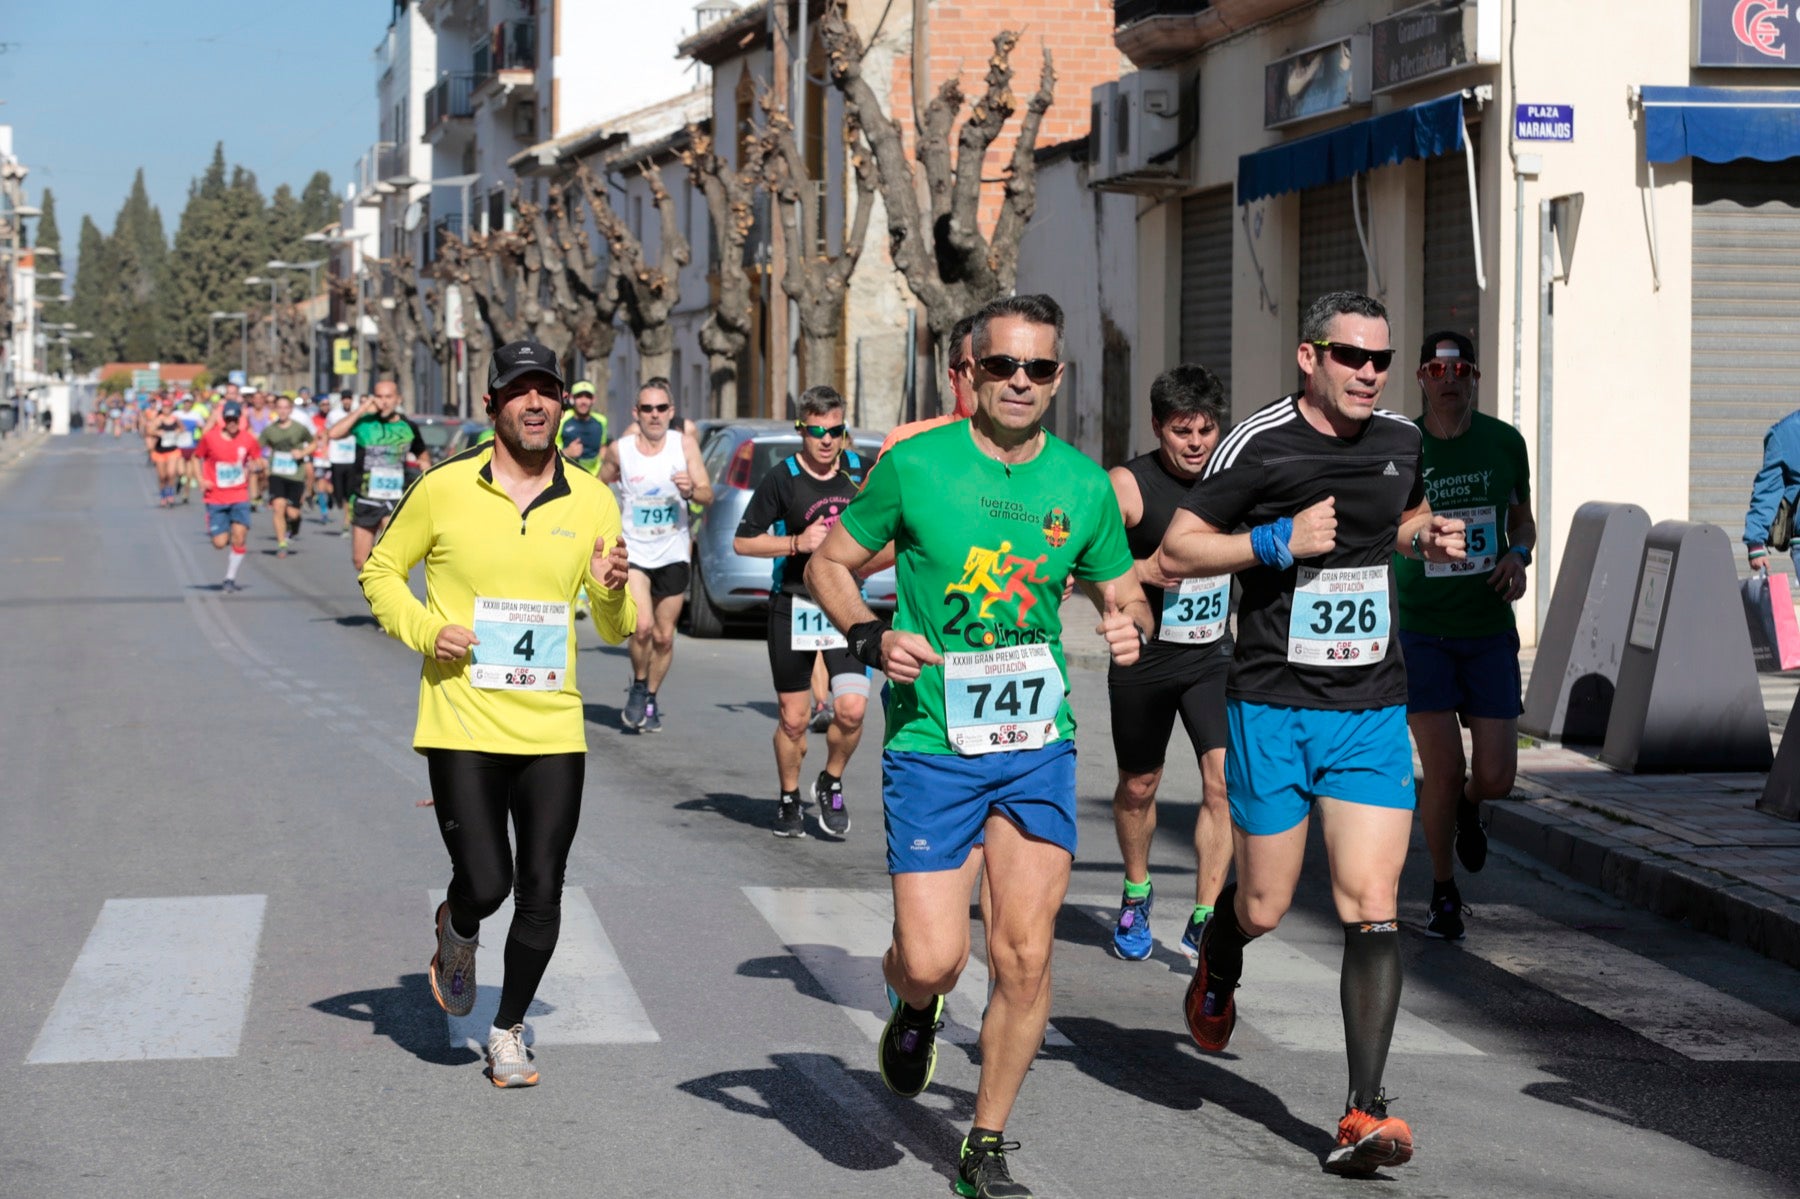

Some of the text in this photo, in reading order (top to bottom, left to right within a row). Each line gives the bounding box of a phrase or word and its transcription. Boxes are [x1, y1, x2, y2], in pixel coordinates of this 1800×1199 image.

[1527, 106, 1559, 118] PLAZA
[1518, 121, 1571, 138] NARANJOS
[1424, 473, 1480, 491] DEPORTES
[1425, 485, 1471, 502] DELFOS
[981, 496, 1023, 512] fuerzas
[640, 507, 673, 523] 797
[989, 509, 1040, 524] armadas
[1321, 572, 1338, 582] GRAN
[1339, 571, 1360, 581] PREMIO
[1361, 570, 1368, 579] DE
[1369, 569, 1384, 578] FONDO
[483, 600, 565, 614] XXXIII GRAN PREMIO DE FONDO
[942, 592, 970, 635] 2
[1177, 591, 1222, 622] 325
[798, 612, 832, 631] 11
[1310, 598, 1377, 635] 326
[513, 629, 535, 661] 4
[952, 646, 1047, 666] XXXIII GRAN PREMIO DE FONDO
[966, 677, 1046, 719] 747
